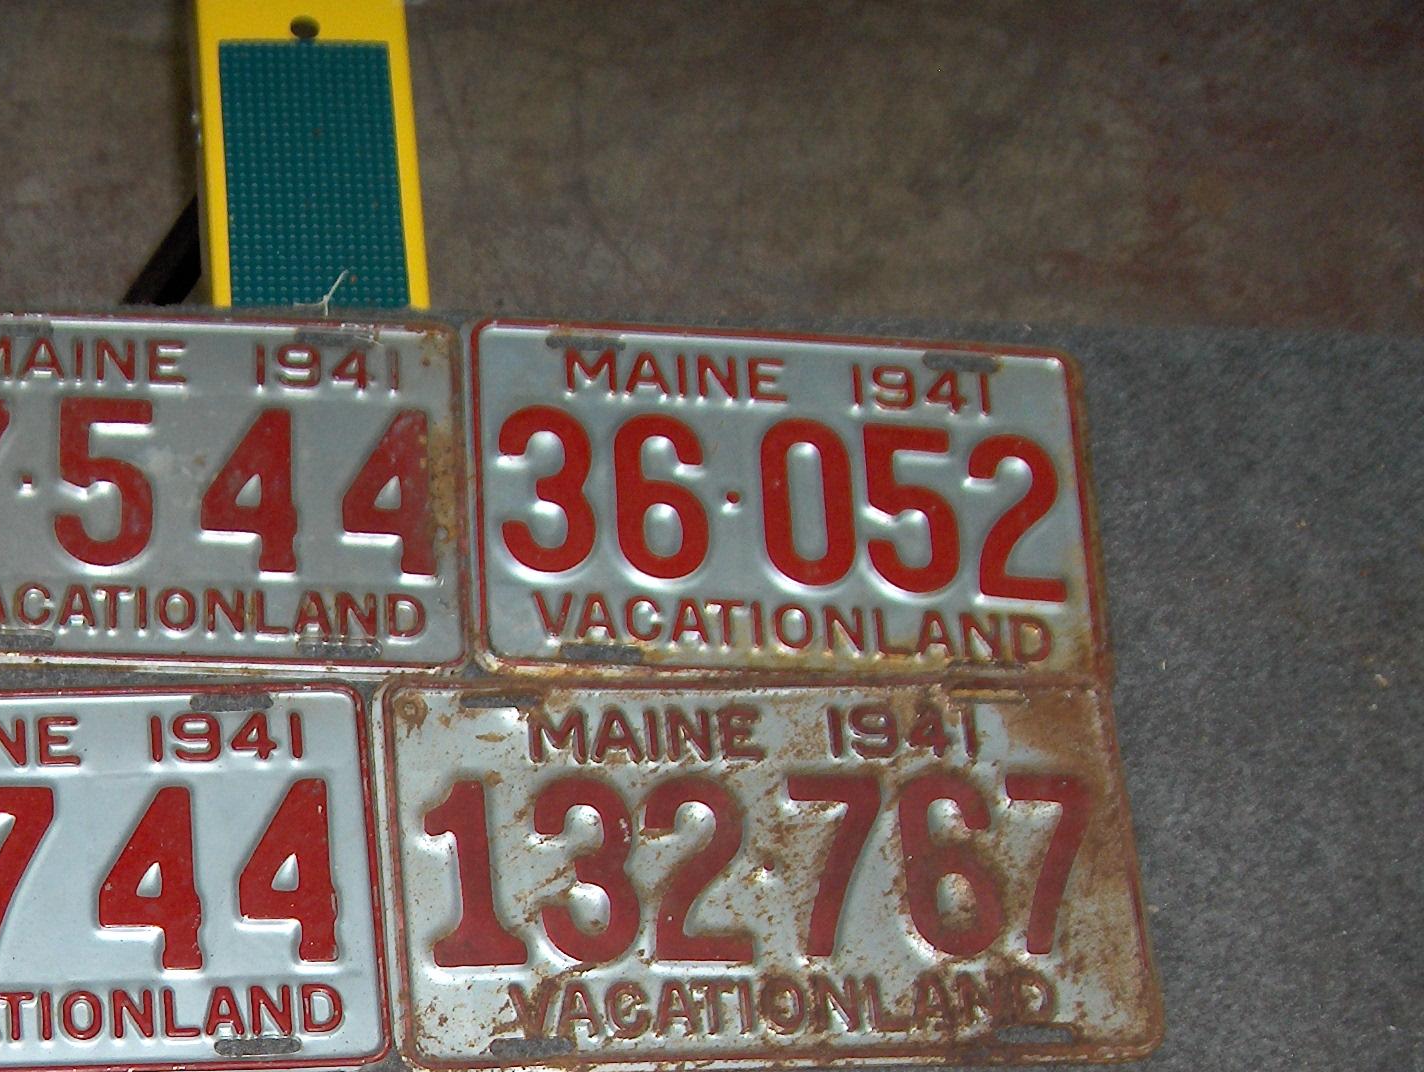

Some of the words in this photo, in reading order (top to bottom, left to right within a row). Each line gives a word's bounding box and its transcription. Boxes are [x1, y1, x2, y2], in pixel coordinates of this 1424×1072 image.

[256, 343, 400, 390] 1941
[563, 349, 787, 401] MAINE
[852, 364, 993, 413] 1941
[532, 591, 1052, 663] VACATIONLAND
[150, 711, 302, 762] 1941
[528, 706, 762, 764] MAINE
[827, 706, 975, 760] 1941
[508, 970, 1054, 1038] VACATIONLAND
